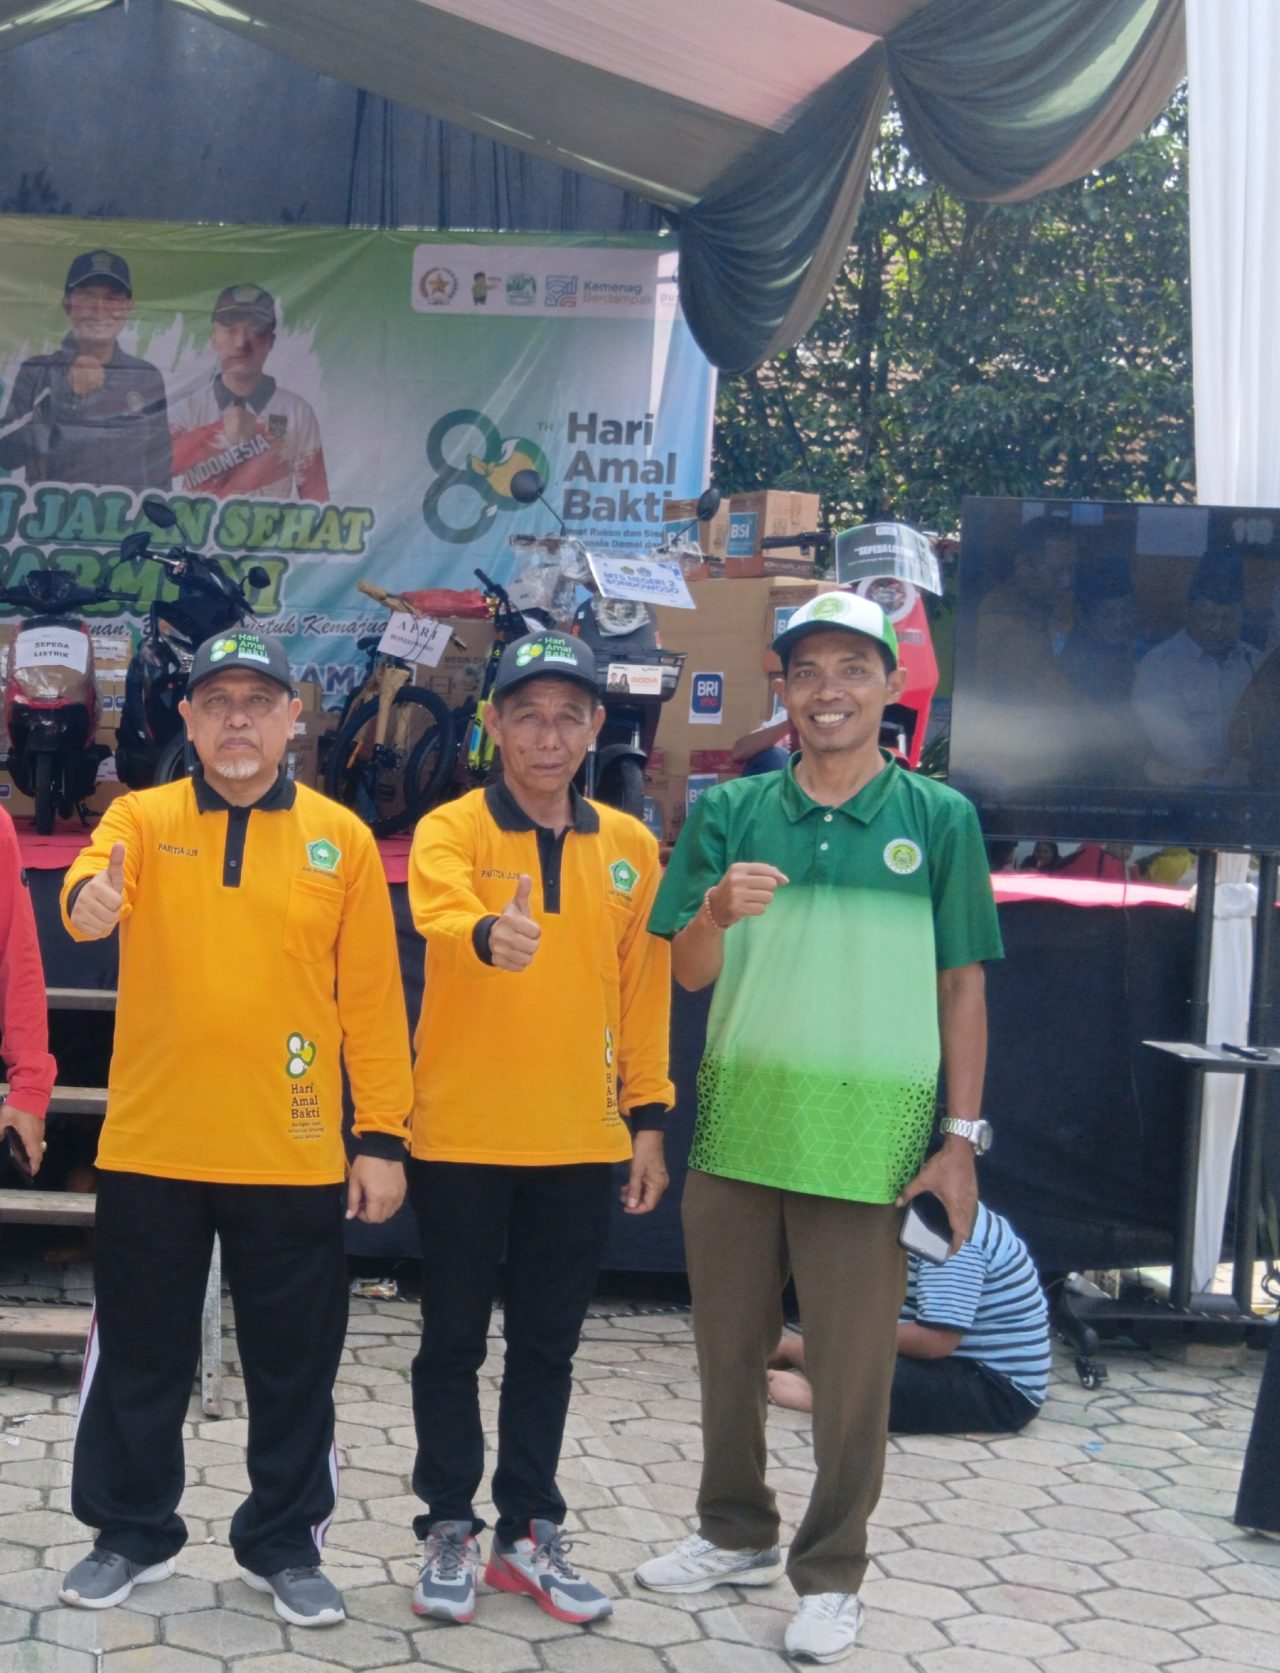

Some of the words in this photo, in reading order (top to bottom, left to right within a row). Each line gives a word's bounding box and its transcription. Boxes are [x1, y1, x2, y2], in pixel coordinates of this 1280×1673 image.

[584, 281, 642, 295] Kemenag
[537, 422, 554, 432] TH
[567, 411, 655, 446] Hari
[183, 433, 270, 489] INDONESIA
[562, 451, 677, 485] Amal
[22, 491, 216, 550] JALAN
[219, 500, 373, 552] SEHAT
[730, 524, 750, 539] BSI
[303, 615, 388, 638] Kemajua
[238, 633, 259, 643] Hari
[544, 637, 566, 646] Hari
[34, 641, 70, 650] SEPEDA
[239, 641, 266, 650] Amal
[545, 644, 572, 653] Amal
[238, 648, 267, 657] Bakti
[697, 681, 718, 697] BRI
[158, 843, 185, 855] PANITIA
[291, 1083, 314, 1094] Hari
[291, 1095, 318, 1107] Amal
[291, 1107, 320, 1119] Bakti
